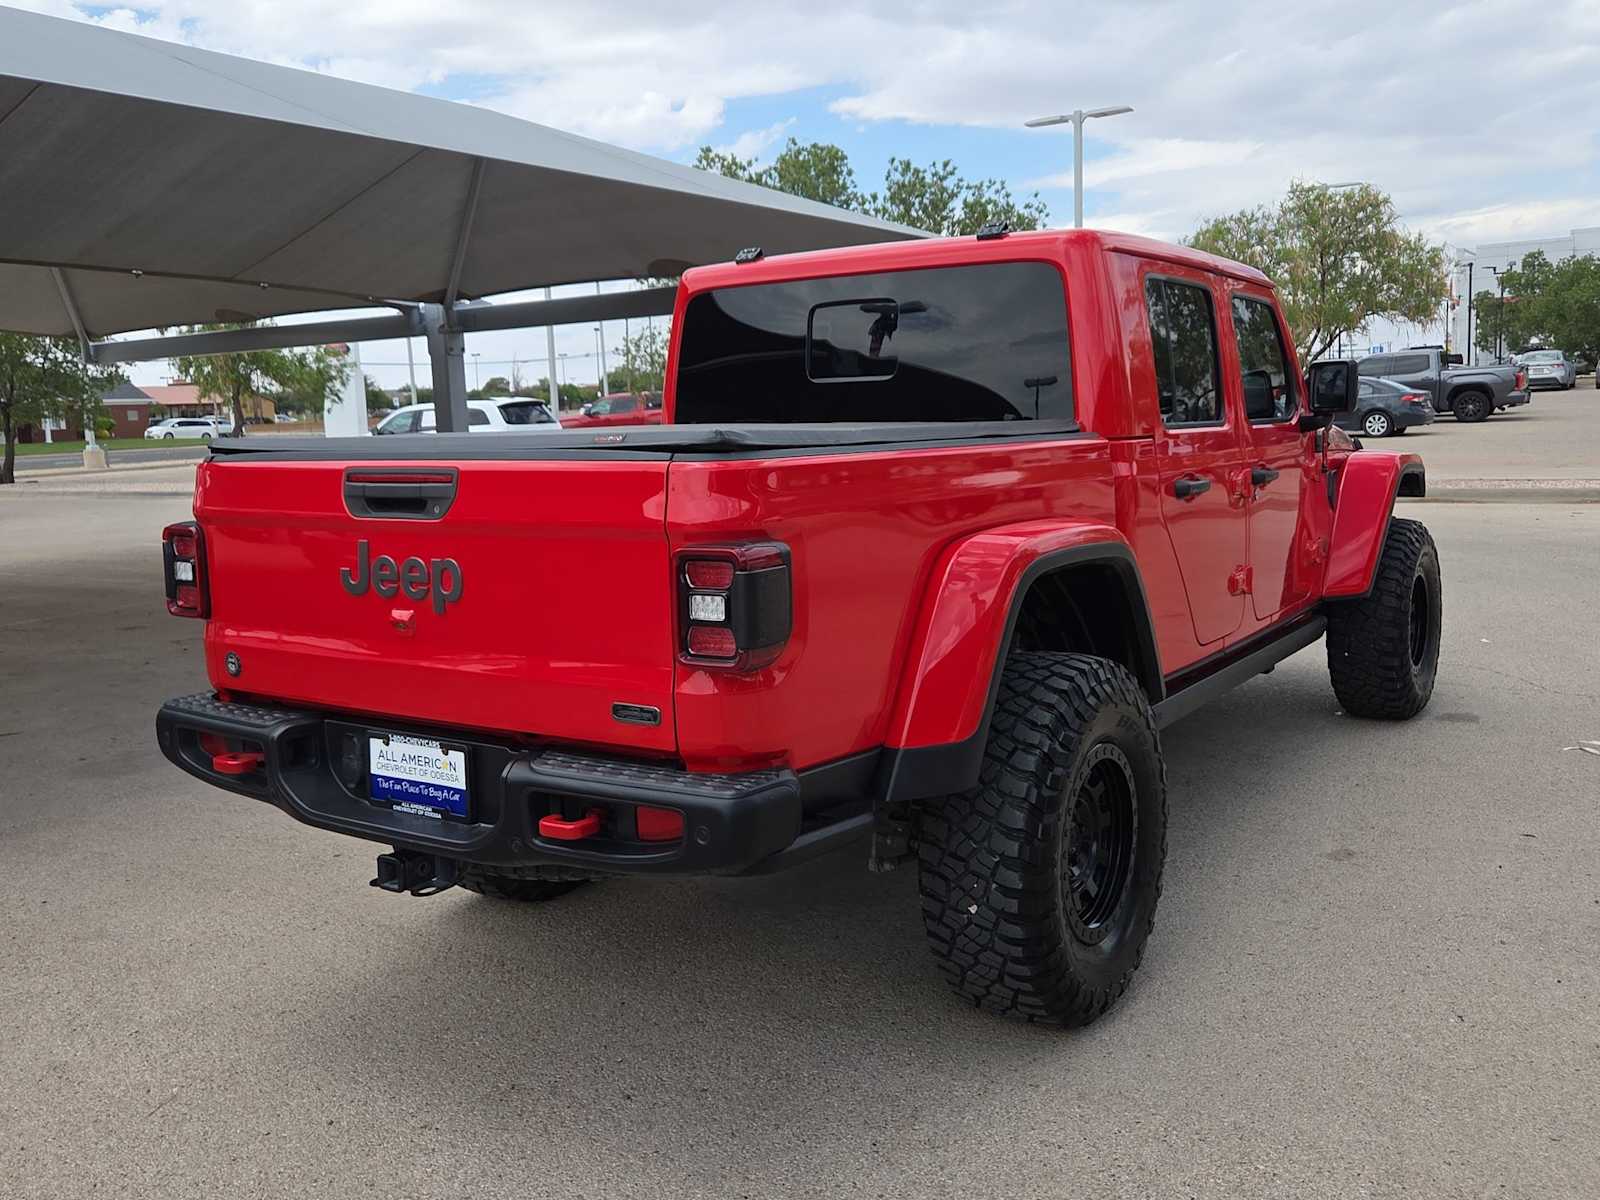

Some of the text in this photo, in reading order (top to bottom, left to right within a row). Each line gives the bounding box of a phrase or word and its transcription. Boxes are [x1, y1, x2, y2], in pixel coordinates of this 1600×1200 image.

[340, 539, 463, 615] Jeep
[378, 749, 397, 763] ALL
[376, 762, 459, 783] CHEVROLET OF ODESSA
[377, 778, 389, 788] The
[401, 782, 419, 793] Place
[419, 785, 428, 795] To
[442, 790, 449, 799] A
